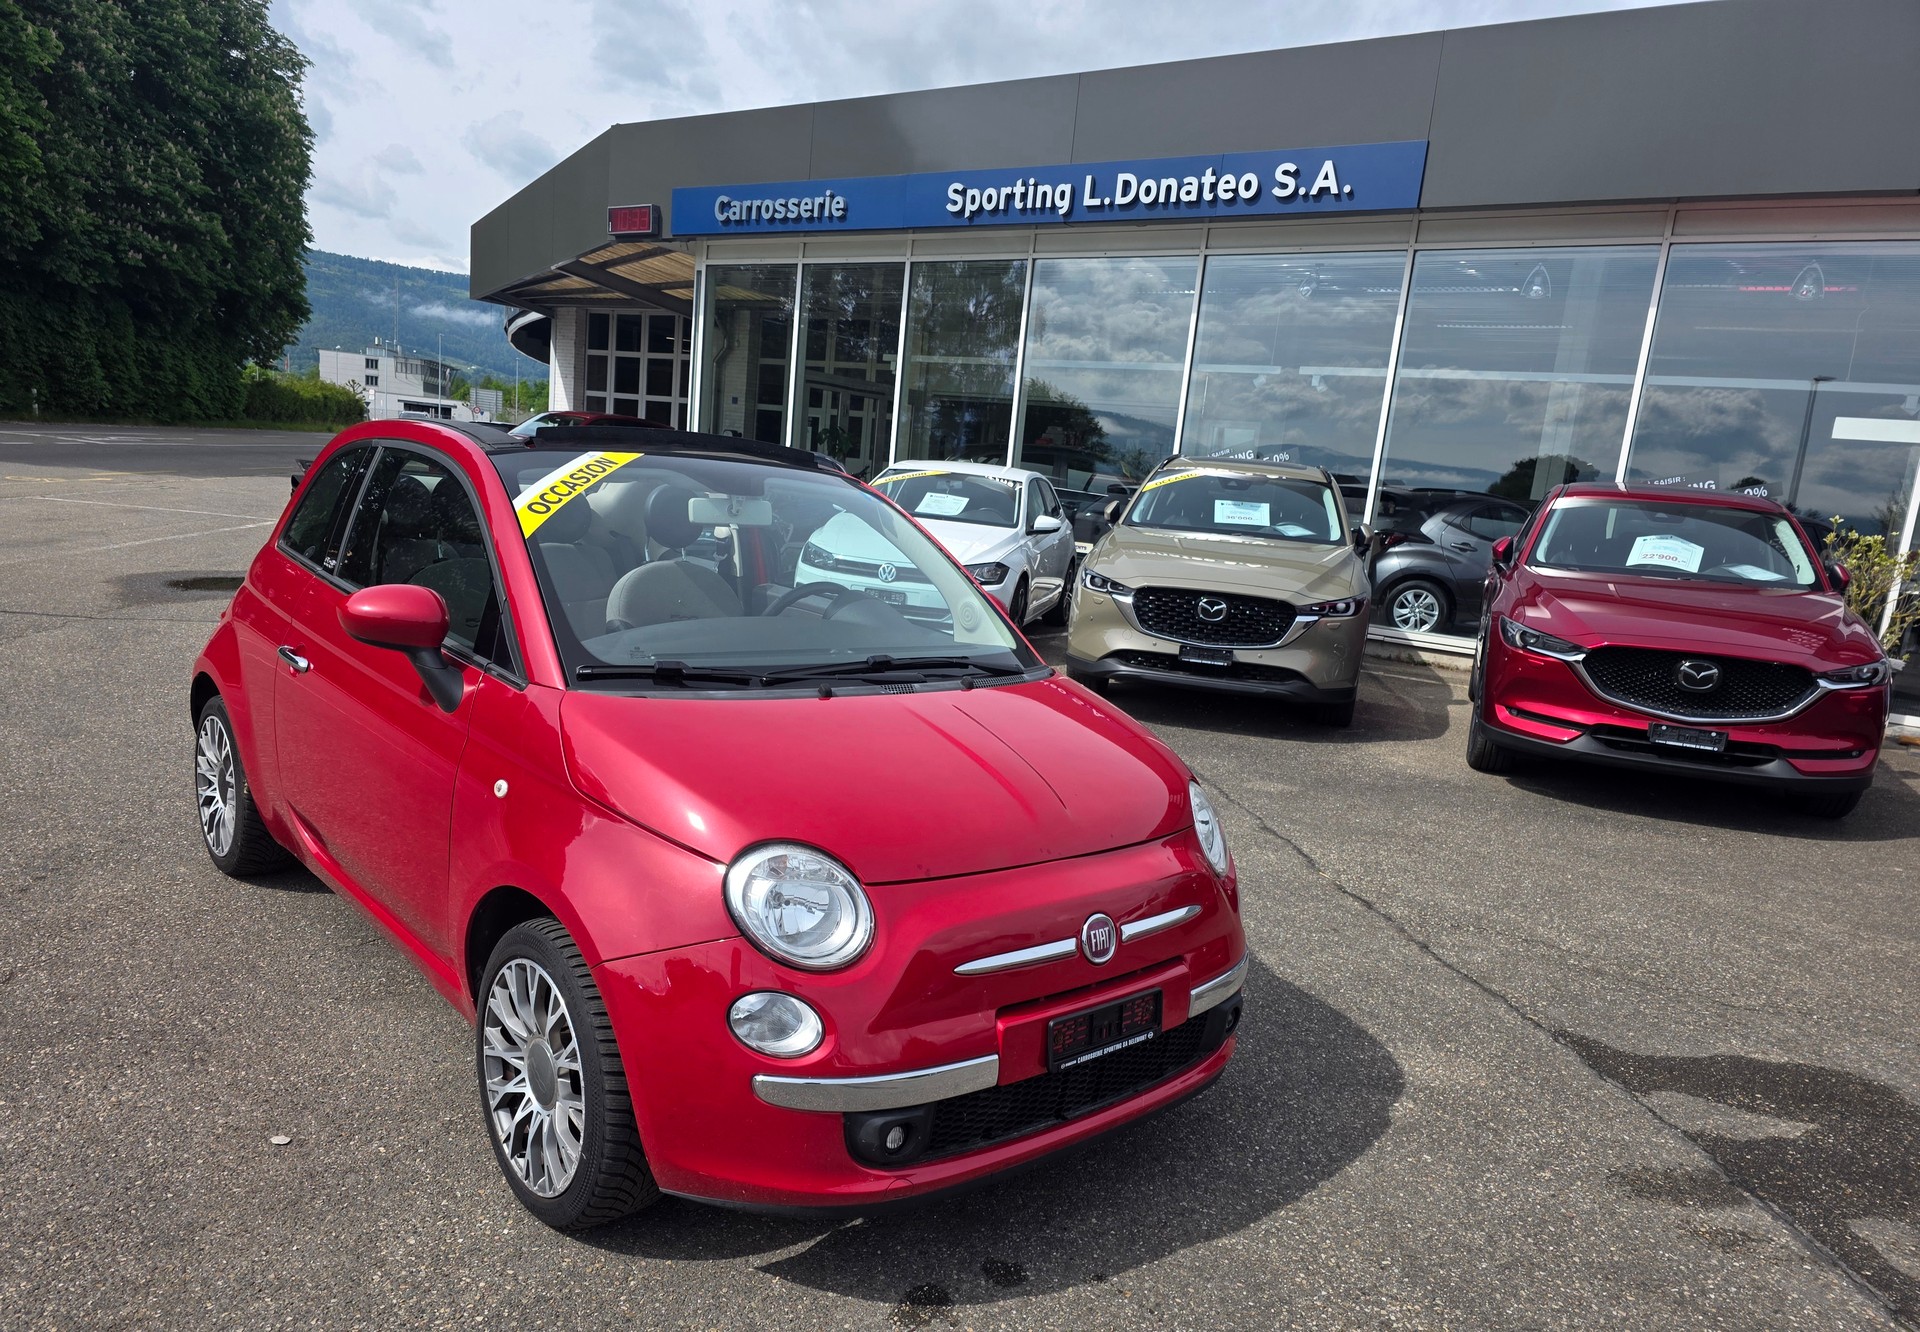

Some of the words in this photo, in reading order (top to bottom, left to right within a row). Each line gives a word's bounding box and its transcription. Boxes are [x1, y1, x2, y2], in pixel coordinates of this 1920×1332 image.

[714, 189, 846, 222] Carrosserie
[945, 177, 1072, 219] Sporting
[1083, 165, 1259, 208] L.Donateo
[1271, 160, 1353, 199] S.A.
[526, 456, 618, 515] OCCASION
[1090, 926, 1109, 952] FIAT
